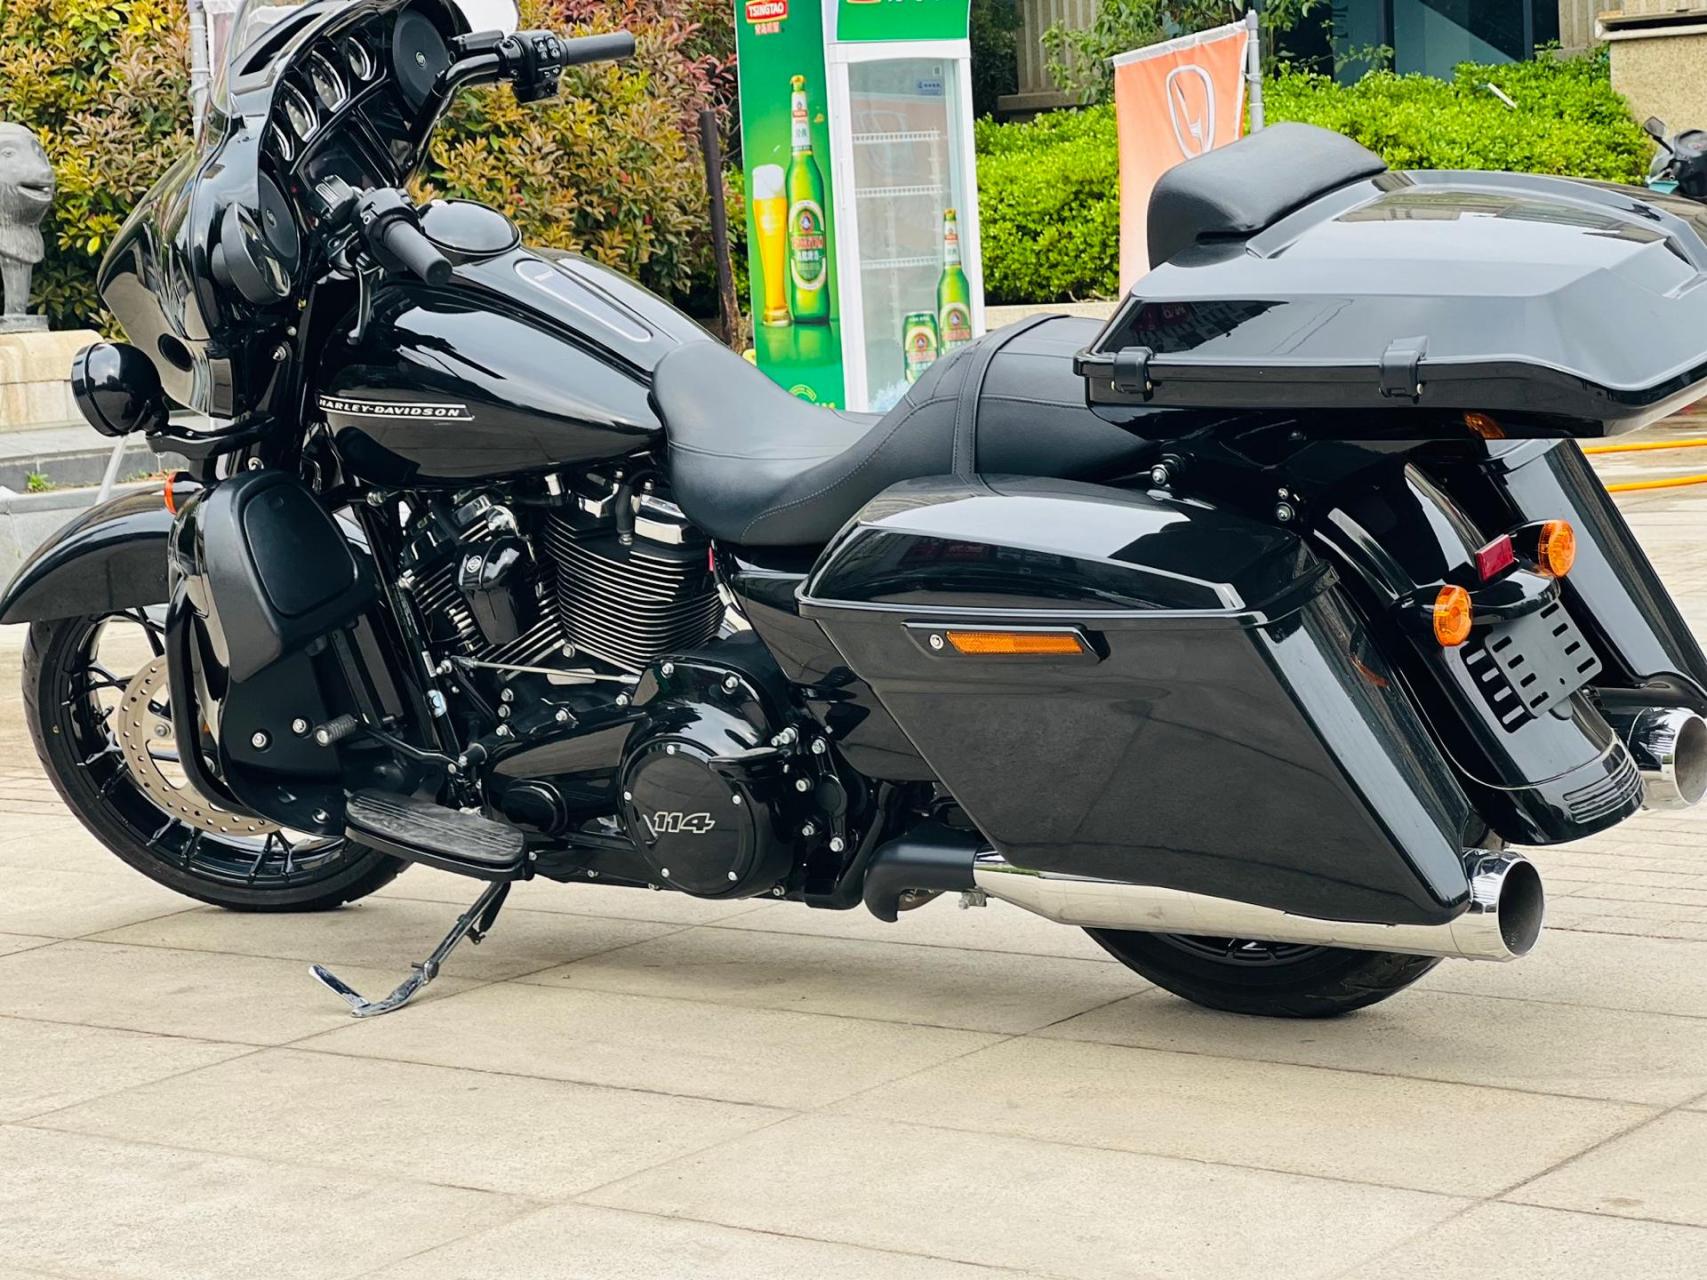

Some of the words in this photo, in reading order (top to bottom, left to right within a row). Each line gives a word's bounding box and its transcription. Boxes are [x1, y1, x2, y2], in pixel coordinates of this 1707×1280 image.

[748, 2, 785, 17] TSINGTAO
[319, 399, 460, 417] HARLEY-DAVIDSON
[653, 811, 716, 834] 114
